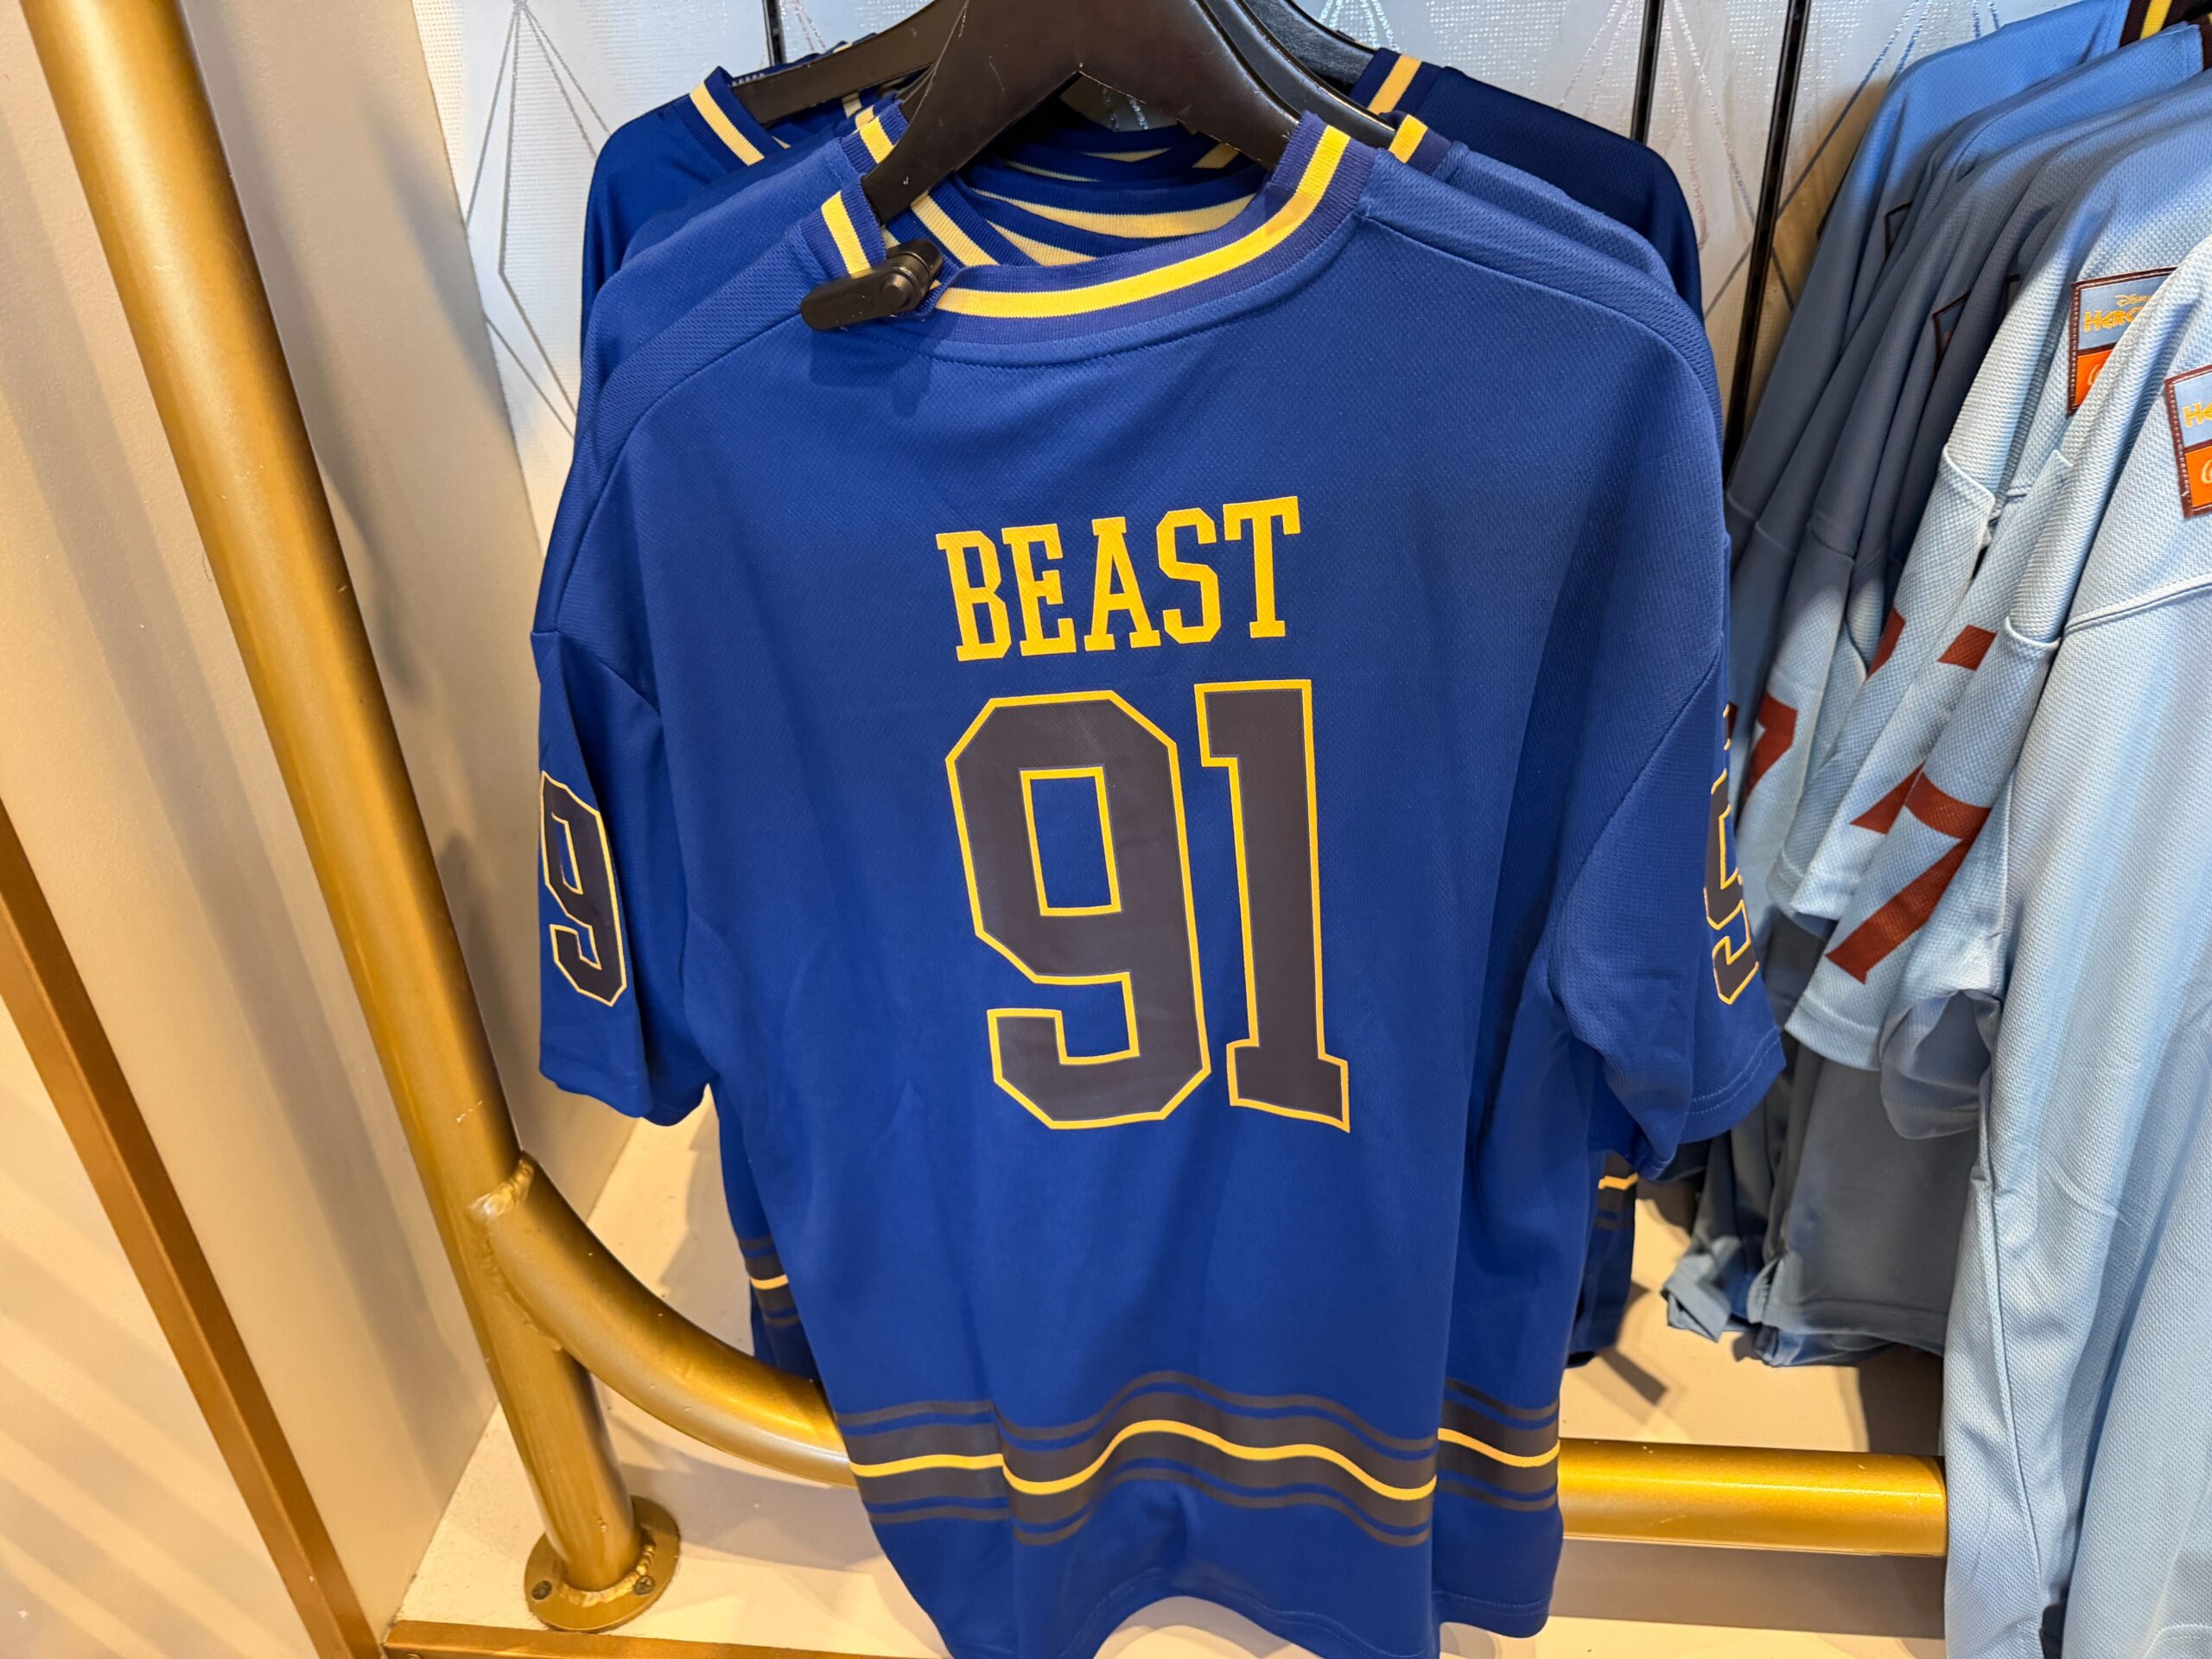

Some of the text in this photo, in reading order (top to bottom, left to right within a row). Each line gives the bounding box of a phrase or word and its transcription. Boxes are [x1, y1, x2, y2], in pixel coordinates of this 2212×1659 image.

[936, 496, 1301, 662] BEAST
[540, 770, 627, 1007] 9
[945, 679, 1351, 1133] 91
